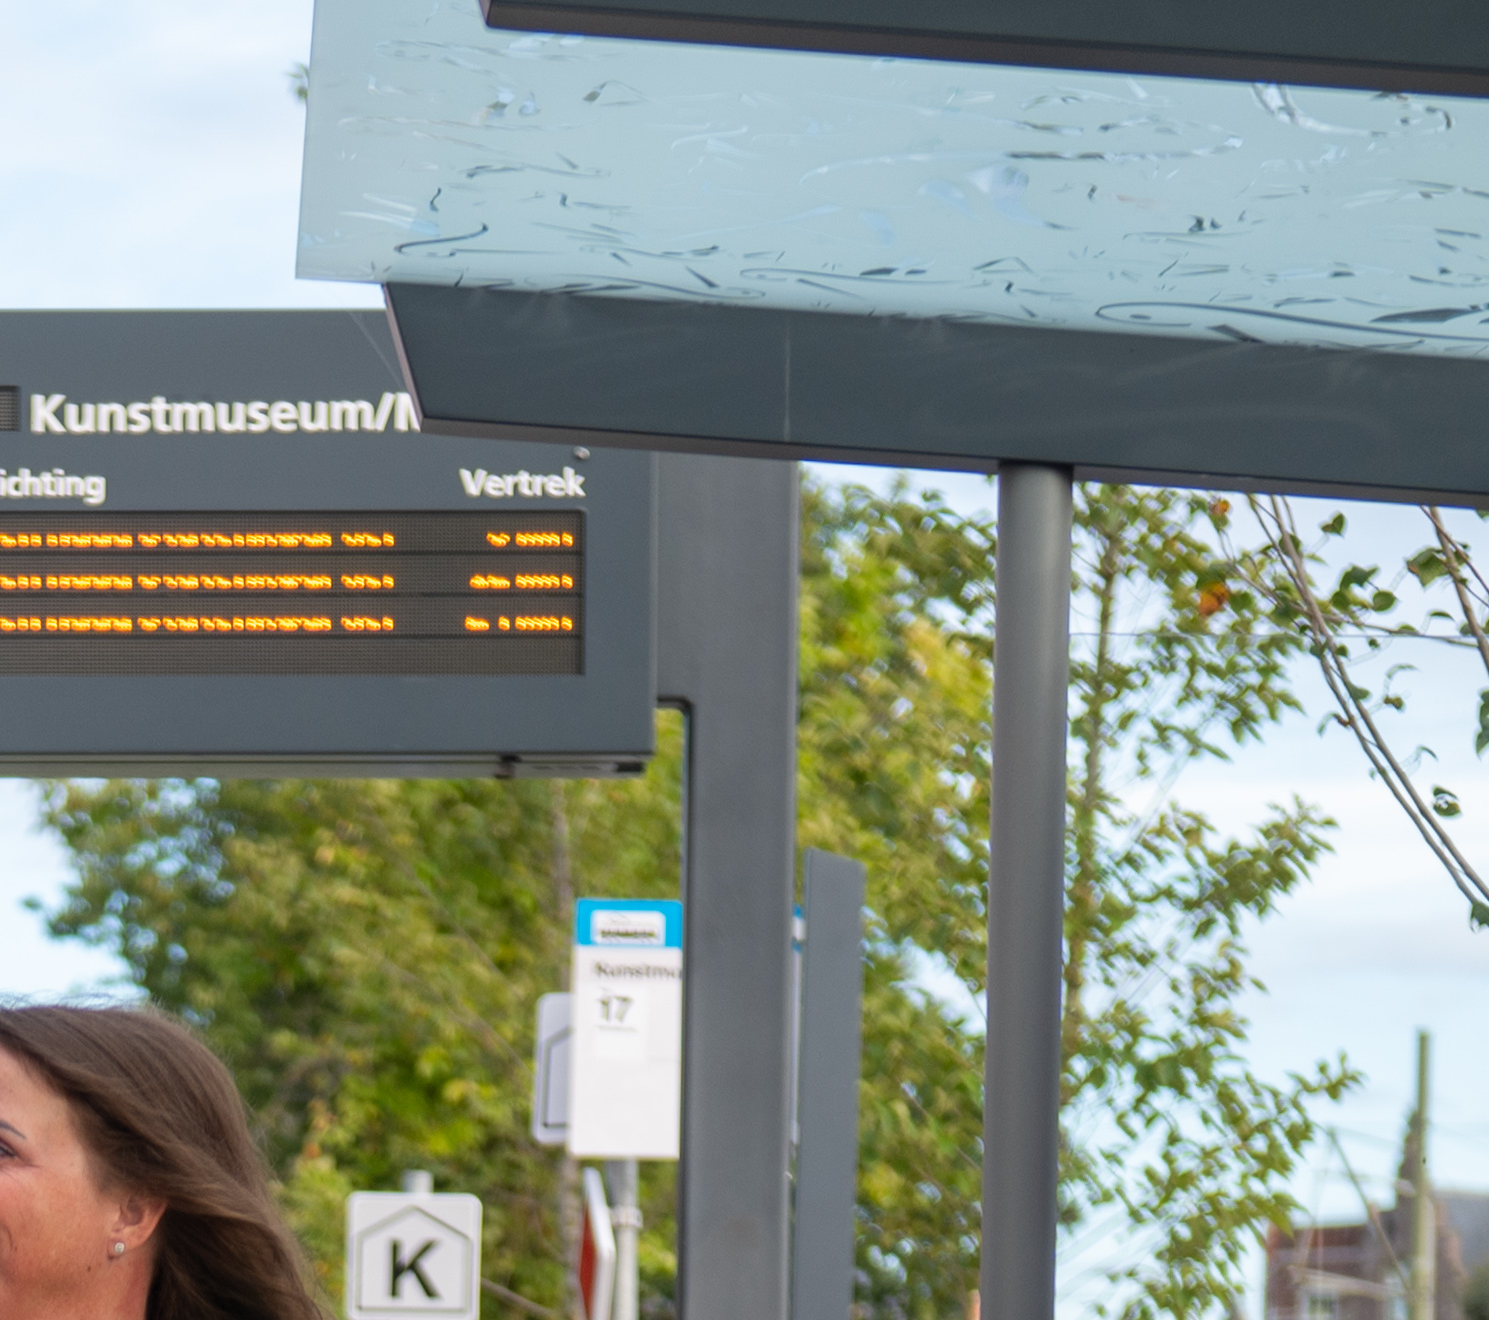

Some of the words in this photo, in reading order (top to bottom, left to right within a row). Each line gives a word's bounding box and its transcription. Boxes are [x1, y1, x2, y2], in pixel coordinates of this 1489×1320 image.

[458, 465, 587, 498] Vertrek
[598, 995, 634, 1023] 17
[389, 1238, 442, 1299] K
